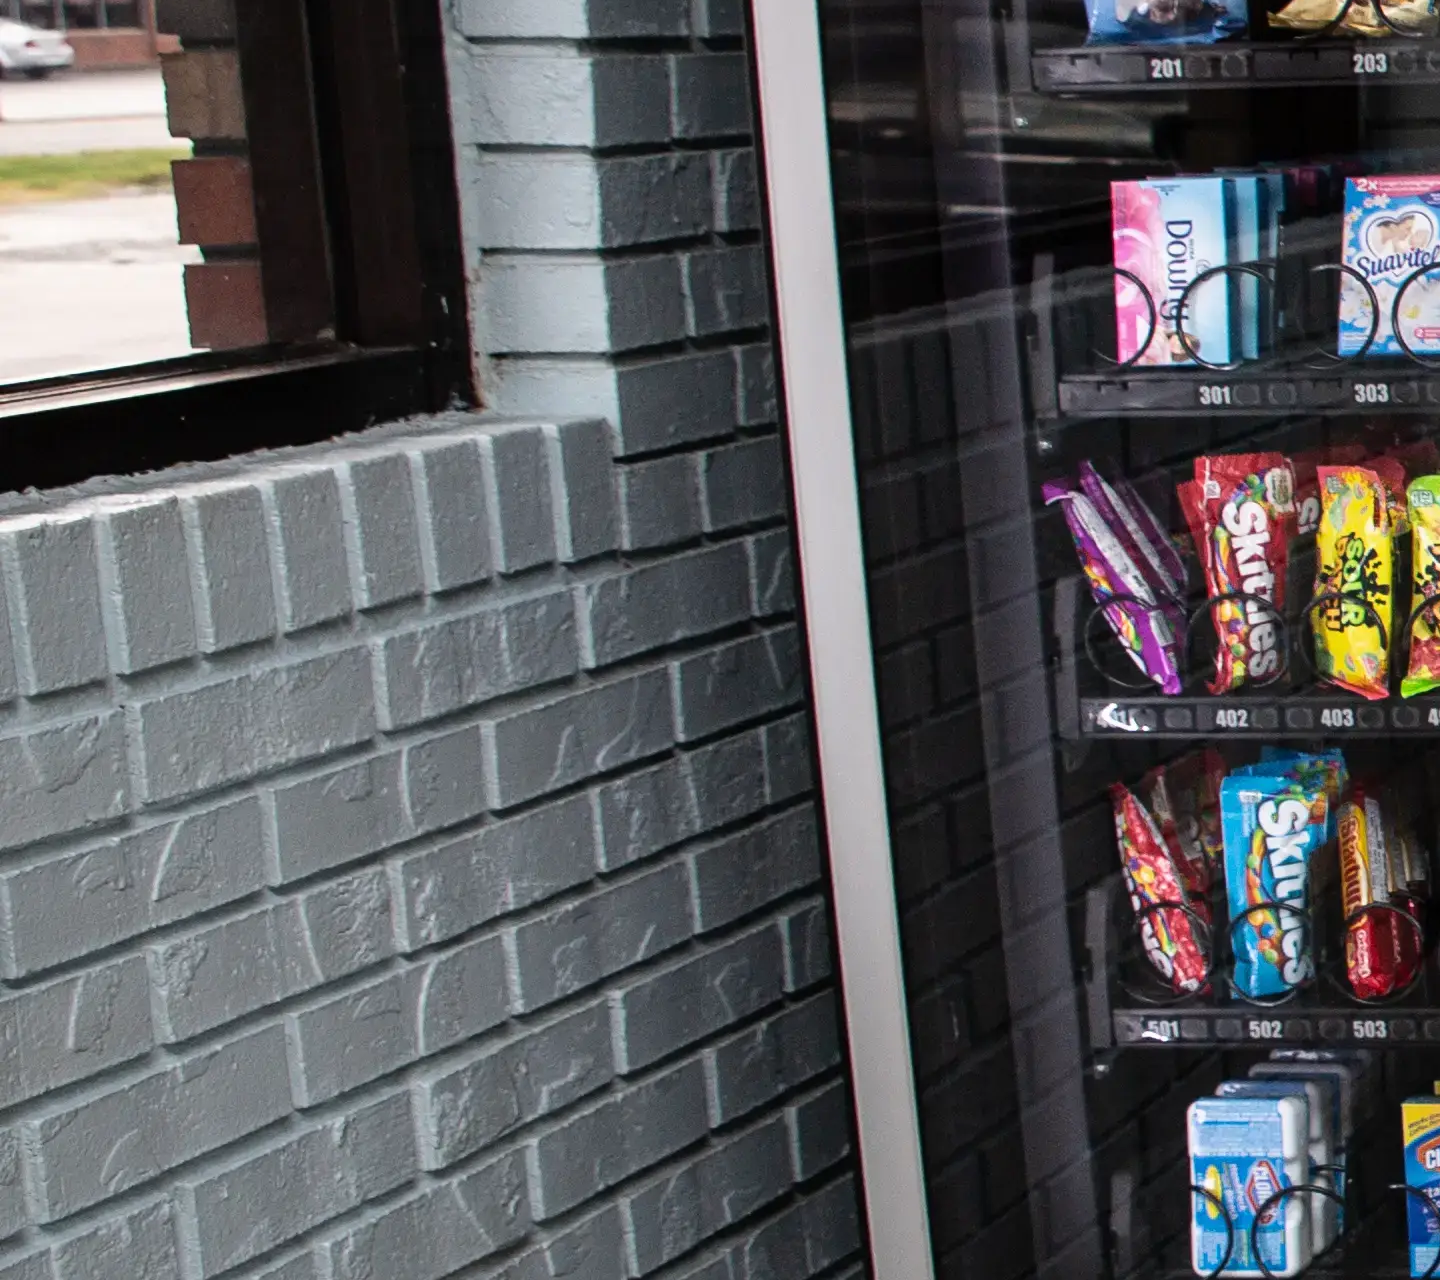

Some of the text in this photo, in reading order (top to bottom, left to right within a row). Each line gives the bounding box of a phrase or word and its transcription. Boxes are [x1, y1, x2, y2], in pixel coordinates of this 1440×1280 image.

[1150, 58, 1183, 79] 201
[1352, 53, 1388, 74] 203
[1356, 244, 1440, 279] Suavitel
[1199, 385, 1231, 405] 301
[1354, 383, 1389, 403] 303
[1221, 501, 1278, 678] Skittles
[1216, 709, 1249, 728] 402
[1320, 708, 1354, 727] 403
[1339, 817, 1362, 914] Starbur
[1257, 799, 1311, 985] Skittles
[1148, 1020, 1180, 1039] 501
[1249, 1020, 1283, 1039] 502
[1353, 1020, 1387, 1039] 503
